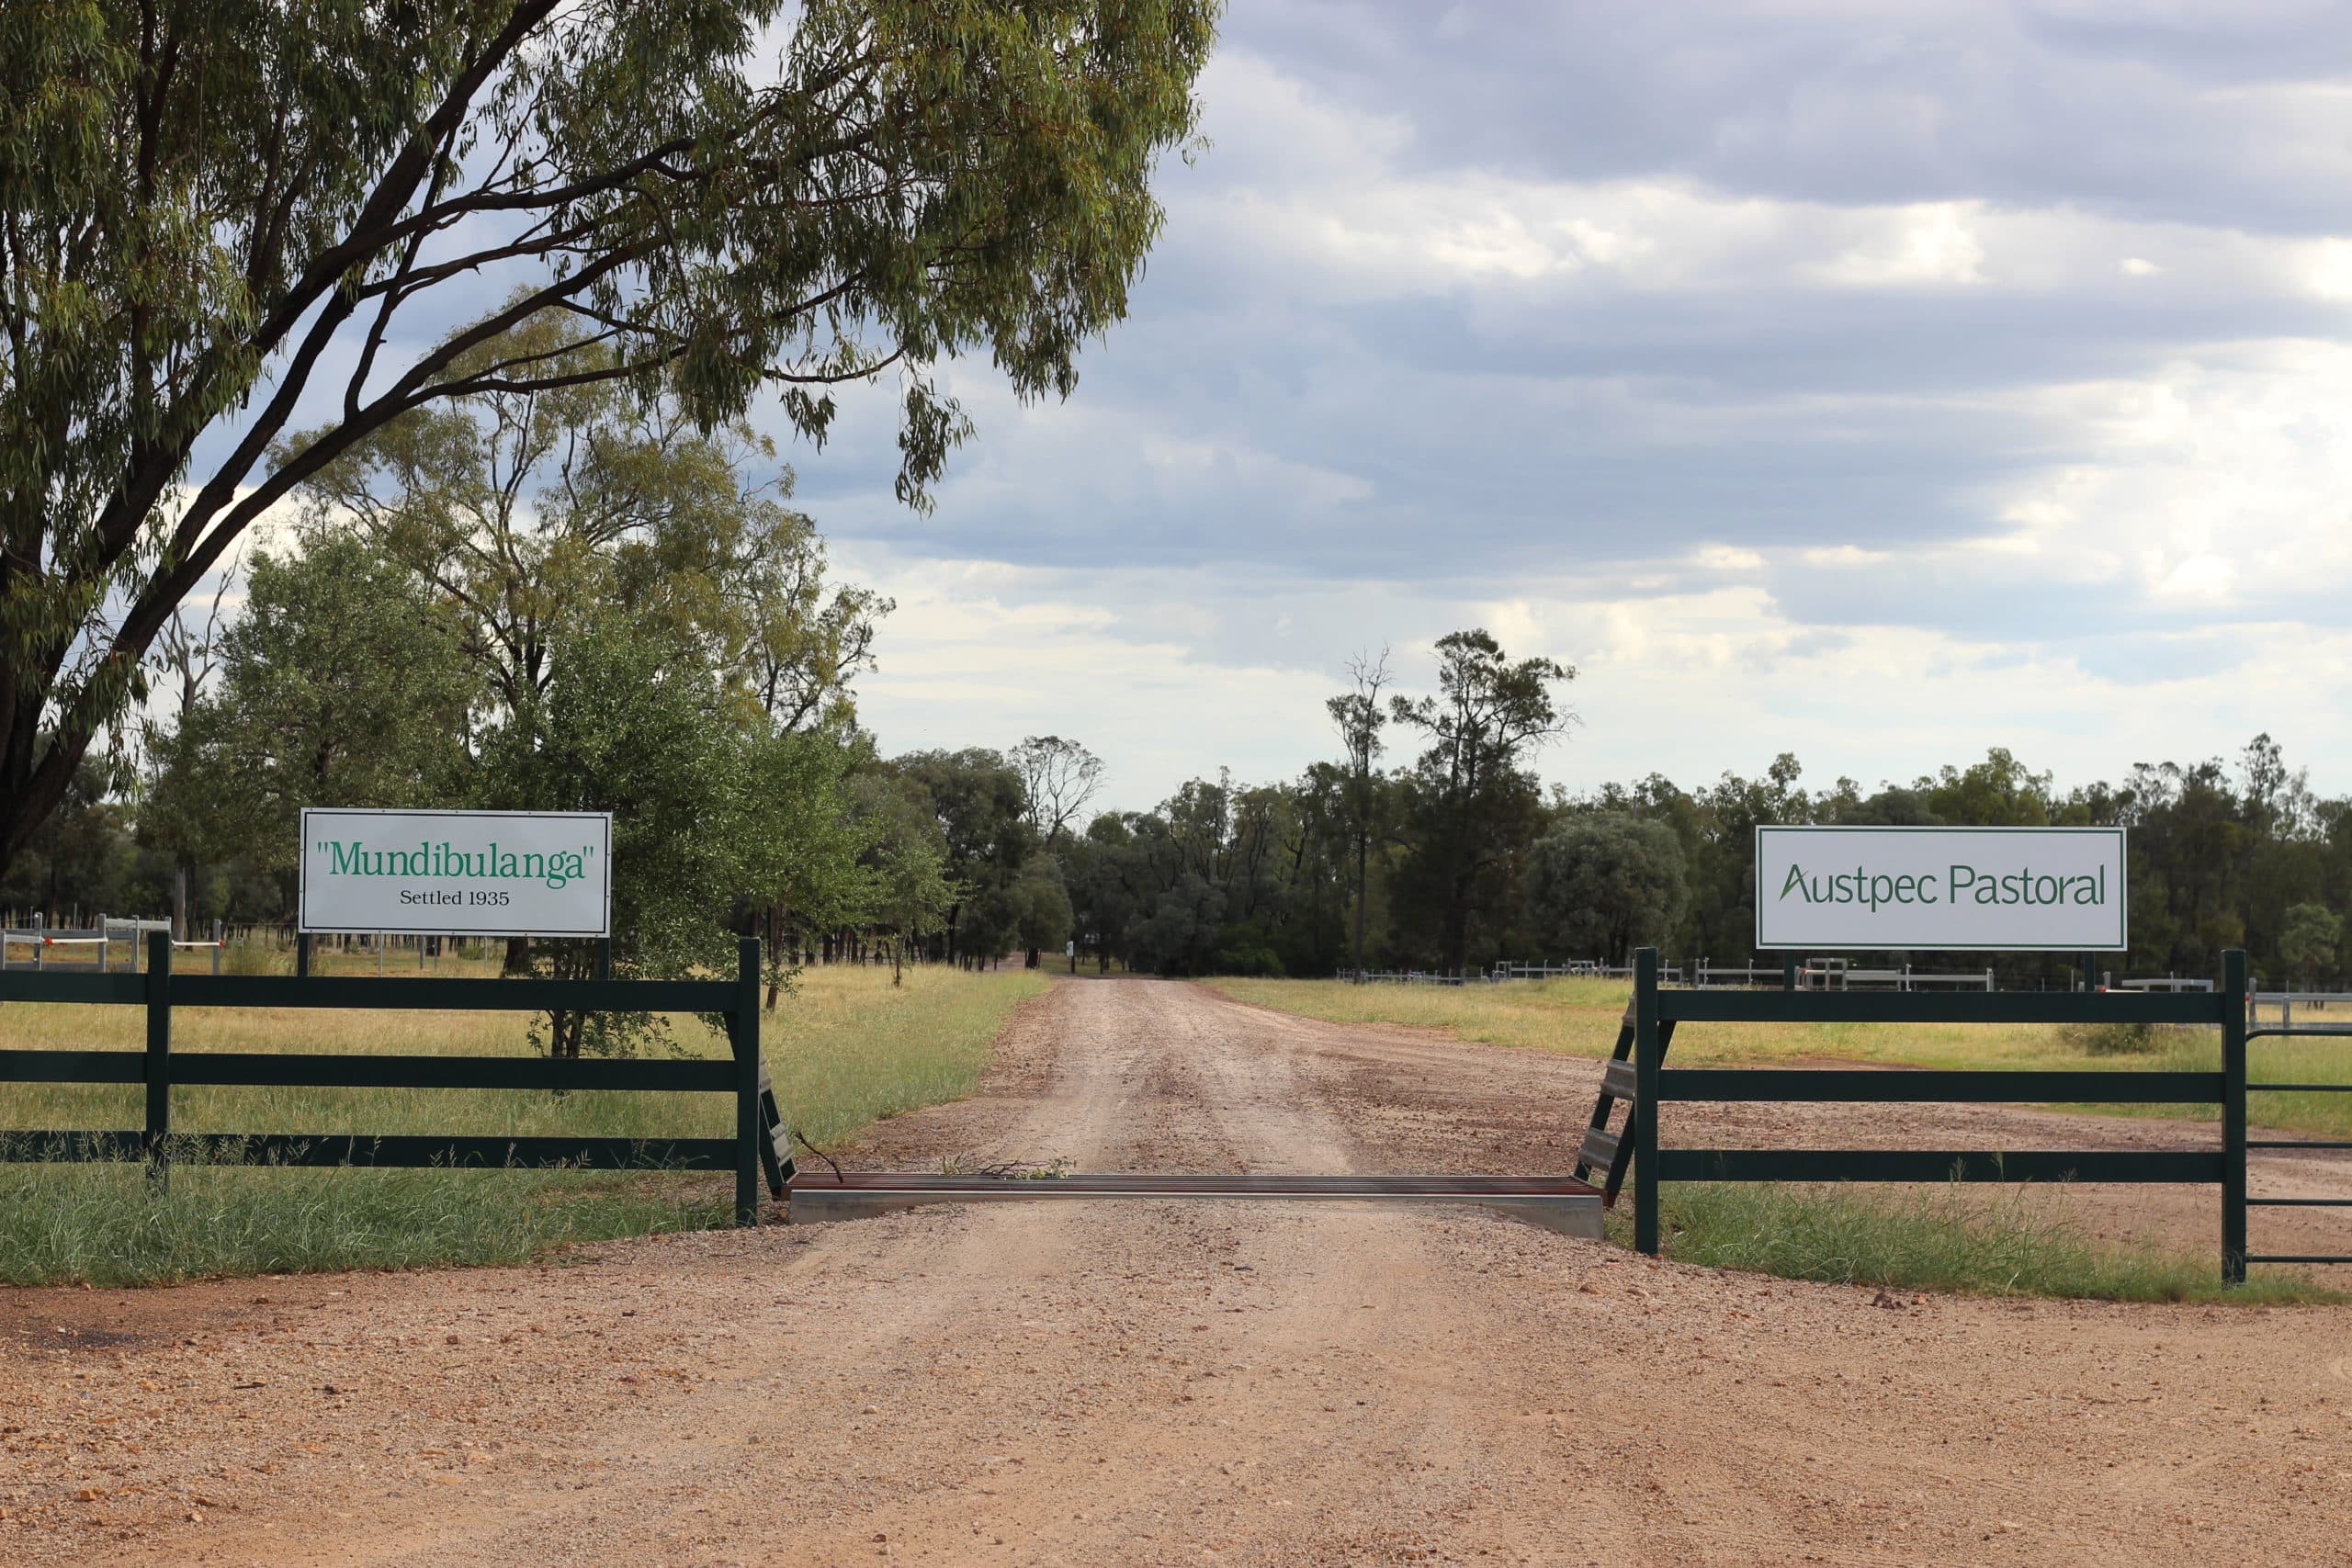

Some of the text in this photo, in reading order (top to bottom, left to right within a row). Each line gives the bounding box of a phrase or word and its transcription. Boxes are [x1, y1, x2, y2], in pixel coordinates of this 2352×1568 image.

[317, 840, 594, 890] "Mundibulanga"
[1779, 863, 2106, 913] Austpec Pastoral
[400, 889, 510, 906] Settled 1935
